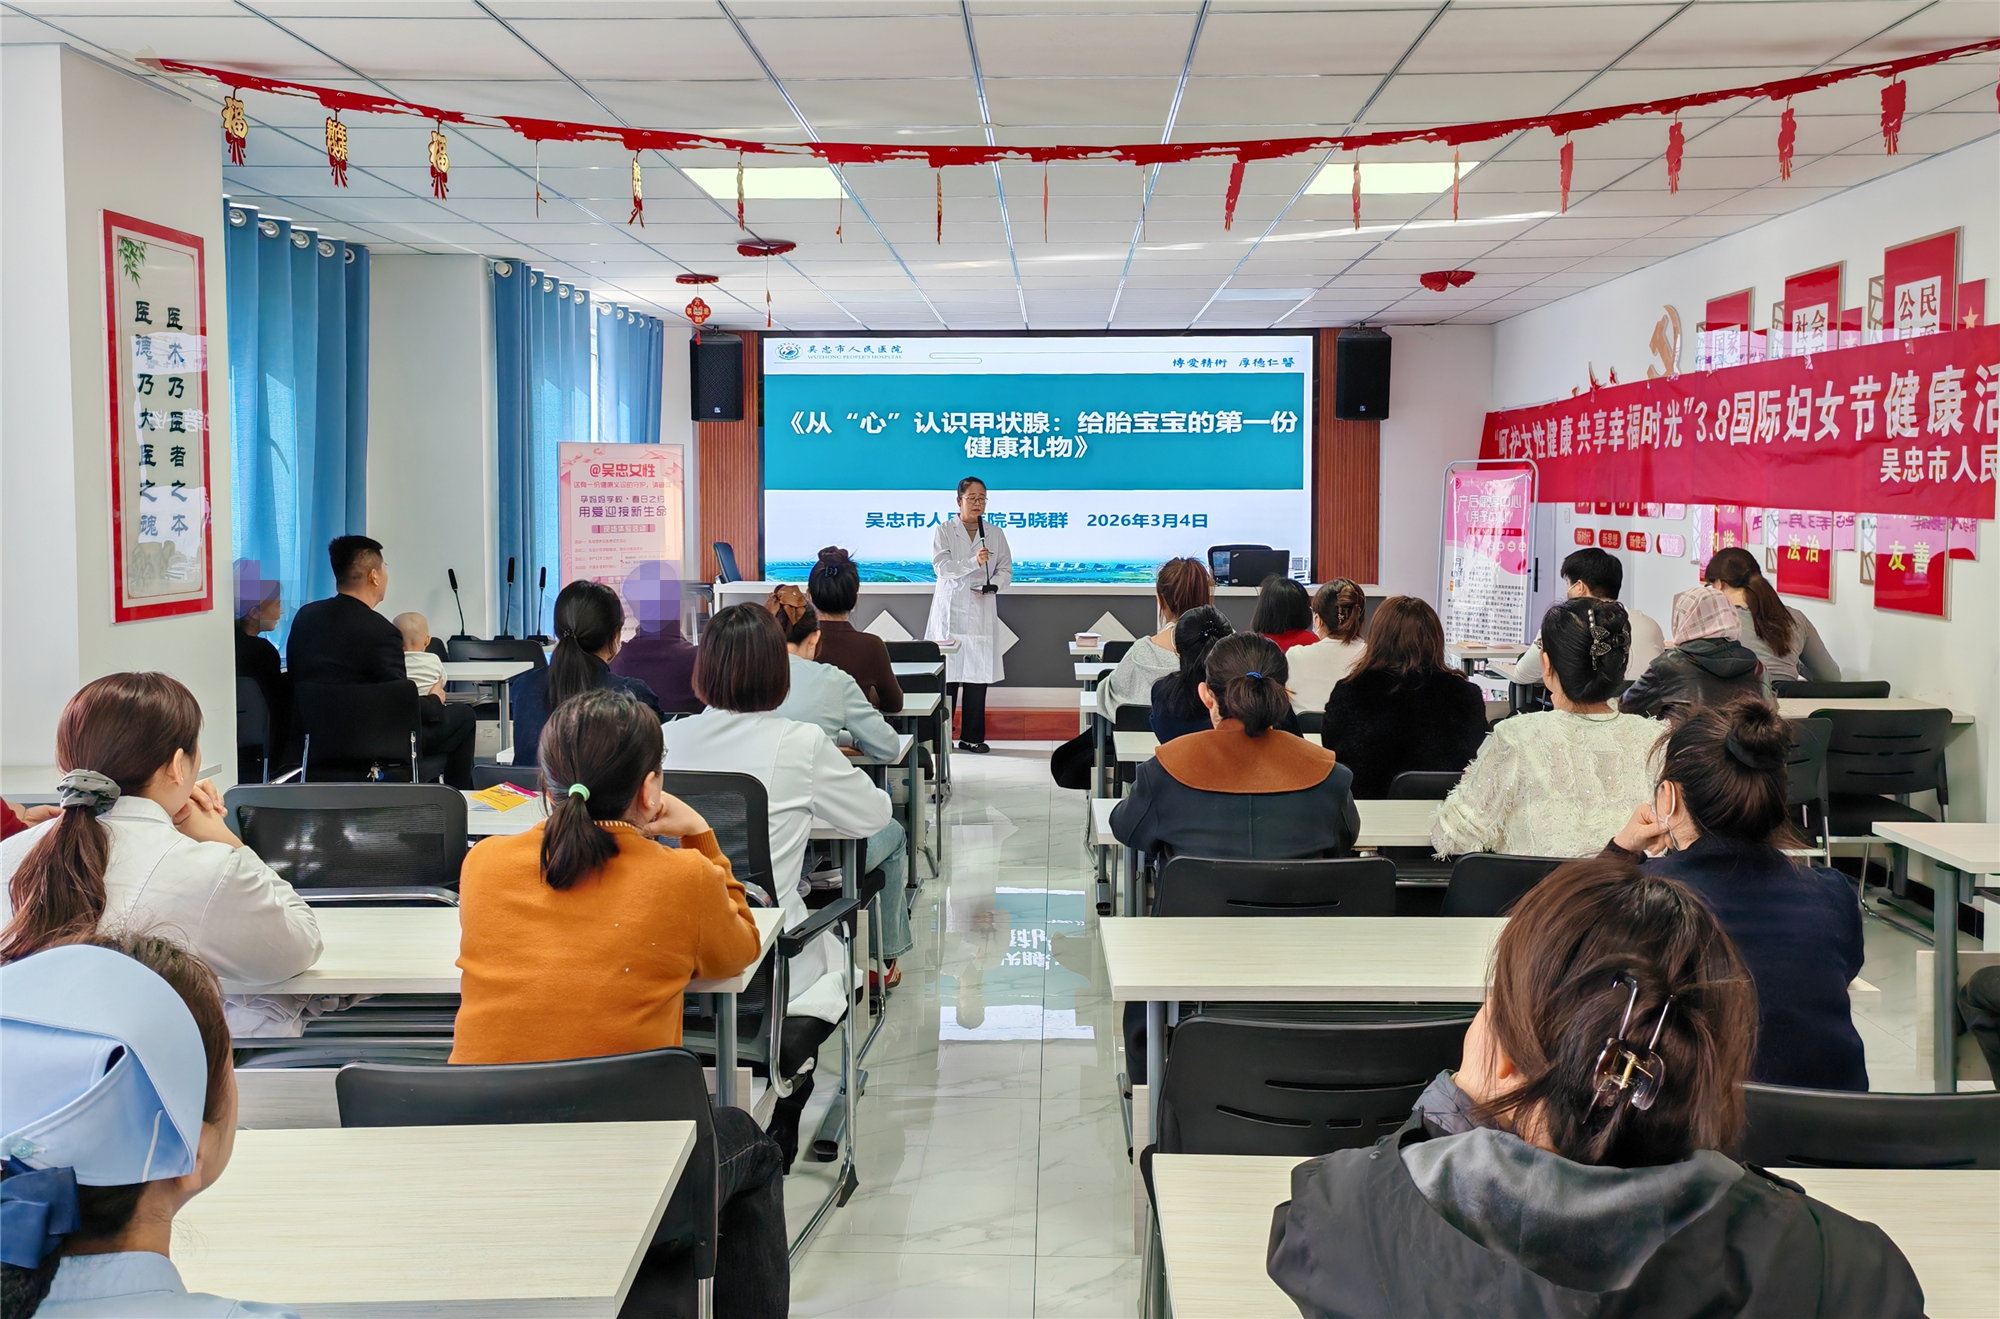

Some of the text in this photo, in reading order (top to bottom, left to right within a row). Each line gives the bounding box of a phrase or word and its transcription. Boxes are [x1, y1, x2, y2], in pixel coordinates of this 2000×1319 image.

[1897, 283, 1938, 322] 公民
[1795, 308, 1826, 345] 社会
[806, 344, 903, 354] 吴忠市人民医院
[1714, 329, 1739, 355] 国家
[964, 435, 1089, 459] 健康礼物》
[589, 463, 656, 478] @吴忠女性
[1879, 444, 1997, 484] 吴忠市人民
[578, 505, 667, 518] 用爱迎接新生命
[1086, 512, 1209, 529] 2026年3月4日
[1786, 533, 1820, 563] 法治
[1887, 540, 1931, 574] 友善
